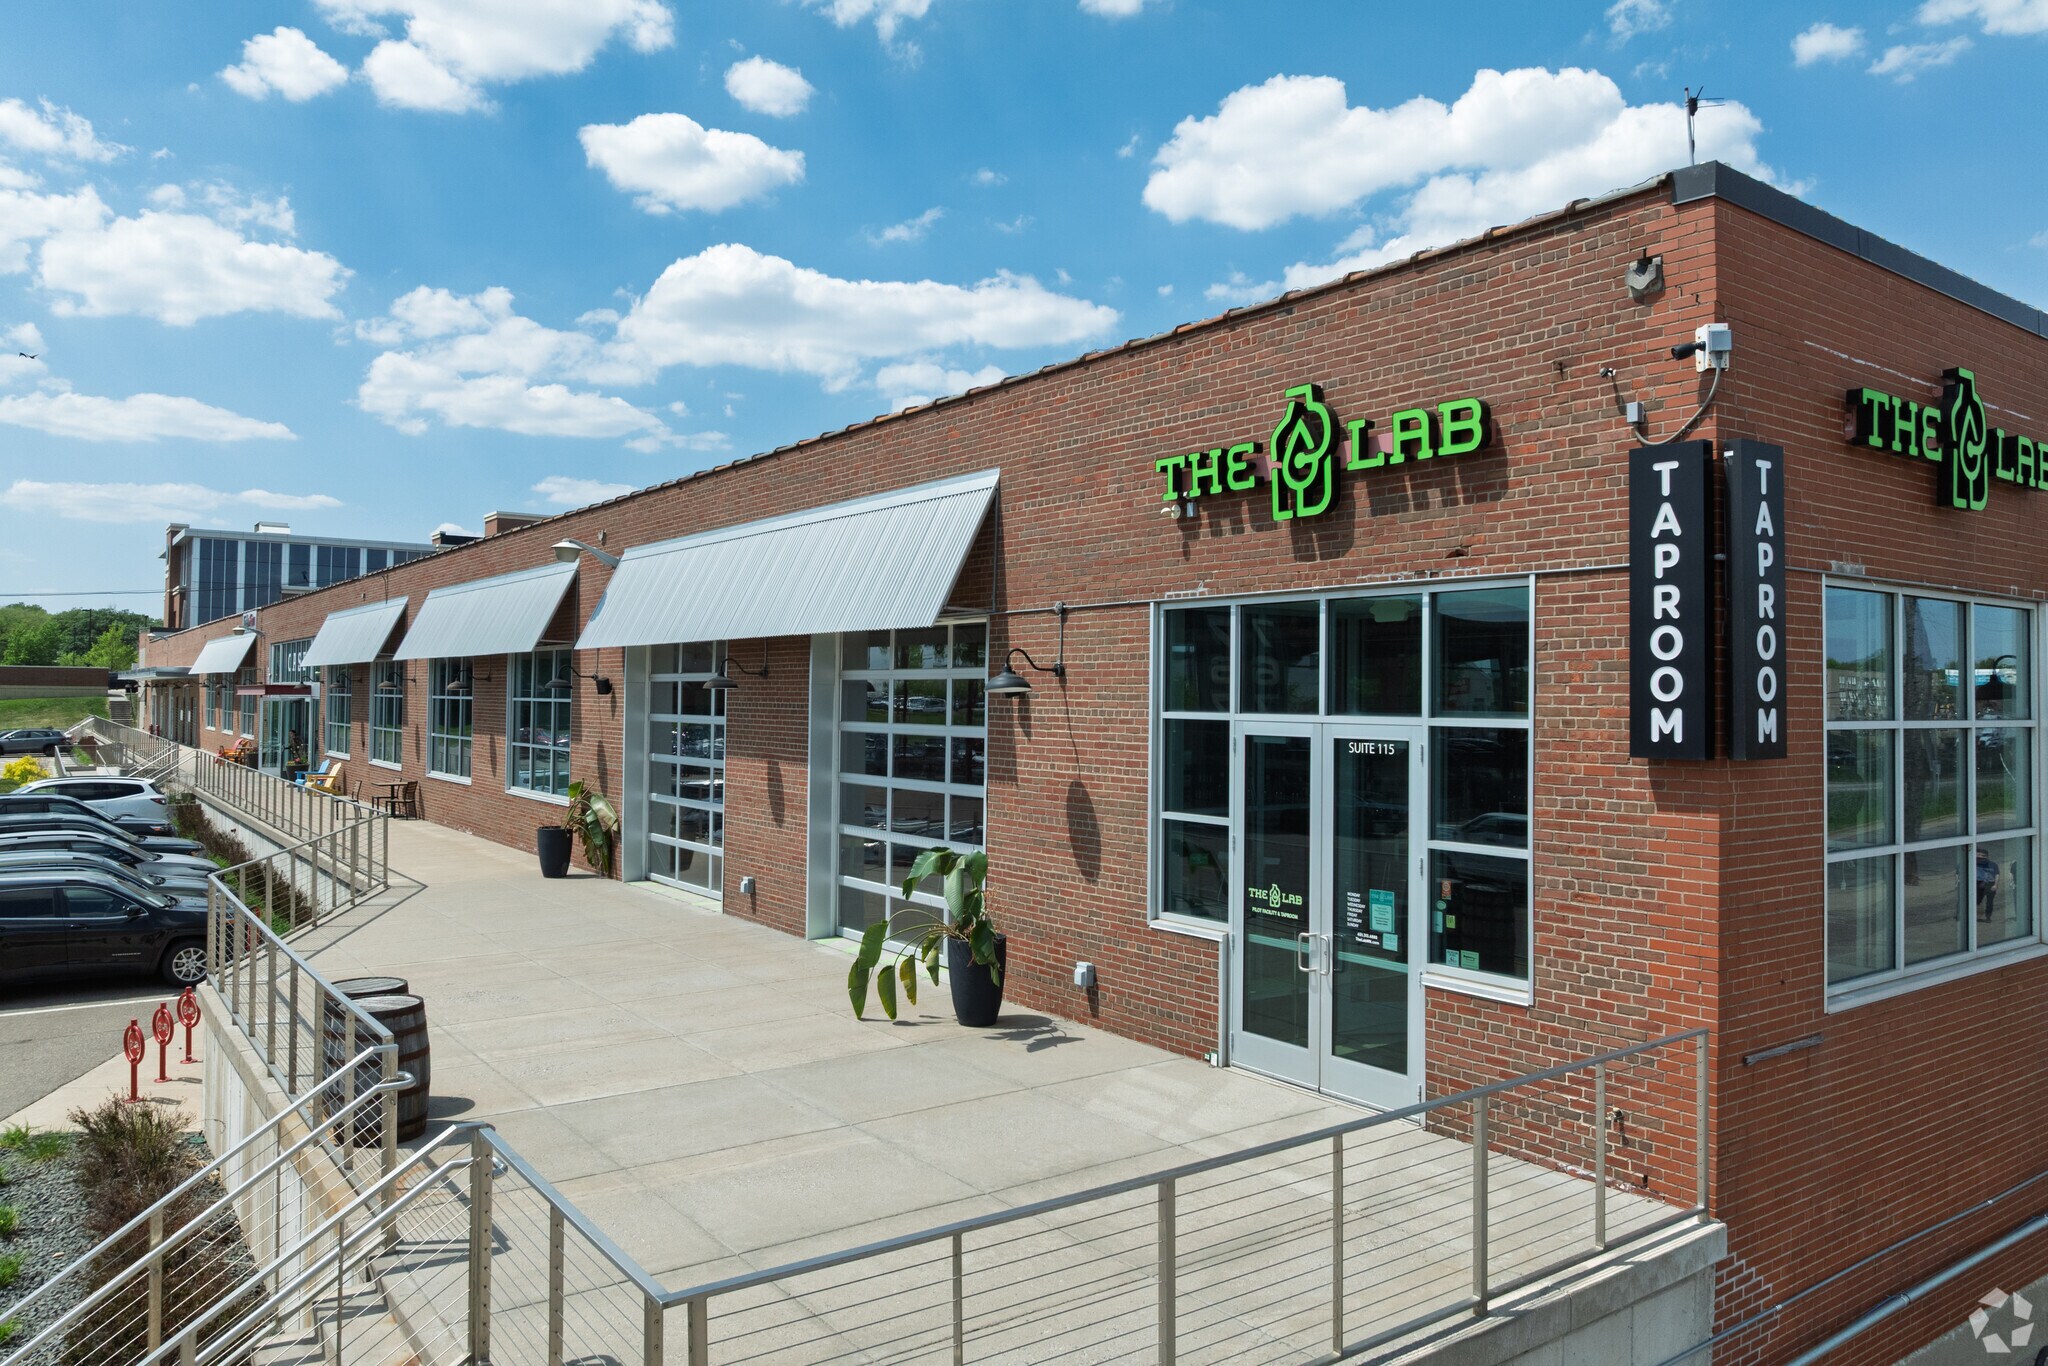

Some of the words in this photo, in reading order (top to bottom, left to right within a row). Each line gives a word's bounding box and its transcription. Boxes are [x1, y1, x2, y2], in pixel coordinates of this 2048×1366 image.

[1155, 443, 1262, 501] THE
[1347, 398, 1485, 471] LAB
[1862, 388, 1943, 461] THE
[1650, 461, 1684, 744] TAPROOM
[1755, 459, 1778, 744] TAPROOM
[1348, 741, 1375, 755] SUITE
[1377, 743, 1395, 755] 115
[1249, 888, 1268, 899] THE
[1282, 894, 1302, 905] LAB
